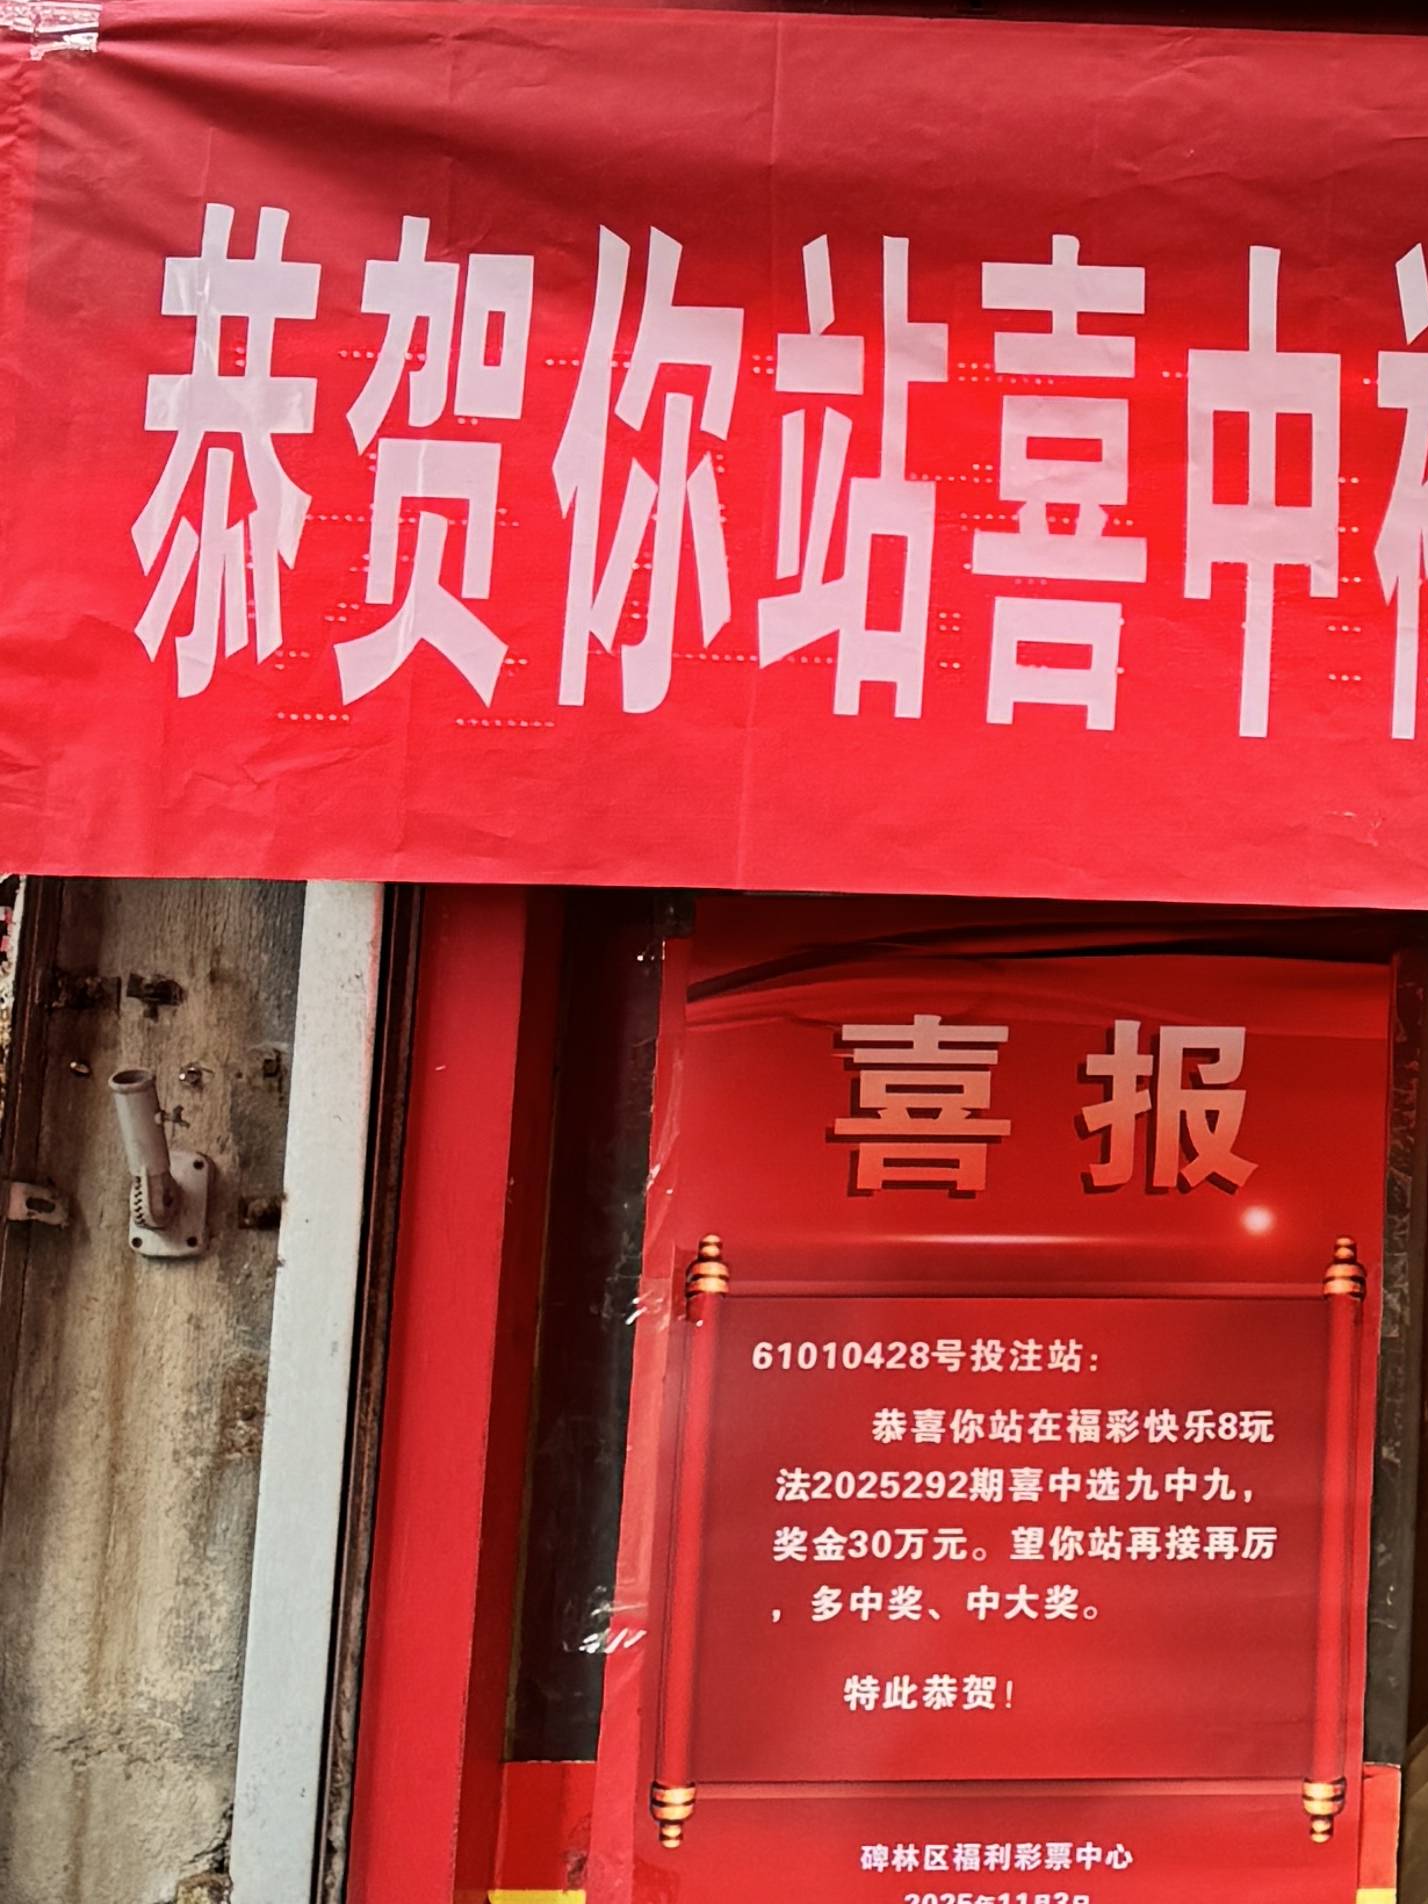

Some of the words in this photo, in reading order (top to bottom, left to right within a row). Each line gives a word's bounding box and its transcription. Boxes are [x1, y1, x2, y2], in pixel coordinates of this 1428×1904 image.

[833, 1014, 1258, 1192] 喜报
[872, 1408, 1275, 1445] 恭喜你站在福彩快乐8玩
[775, 1466, 1254, 1504] 法2025292期喜中选九中九，
[843, 1674, 1014, 1712] 特此恭贺！
[859, 1841, 1134, 1873] 碑林区福利彩票中心
